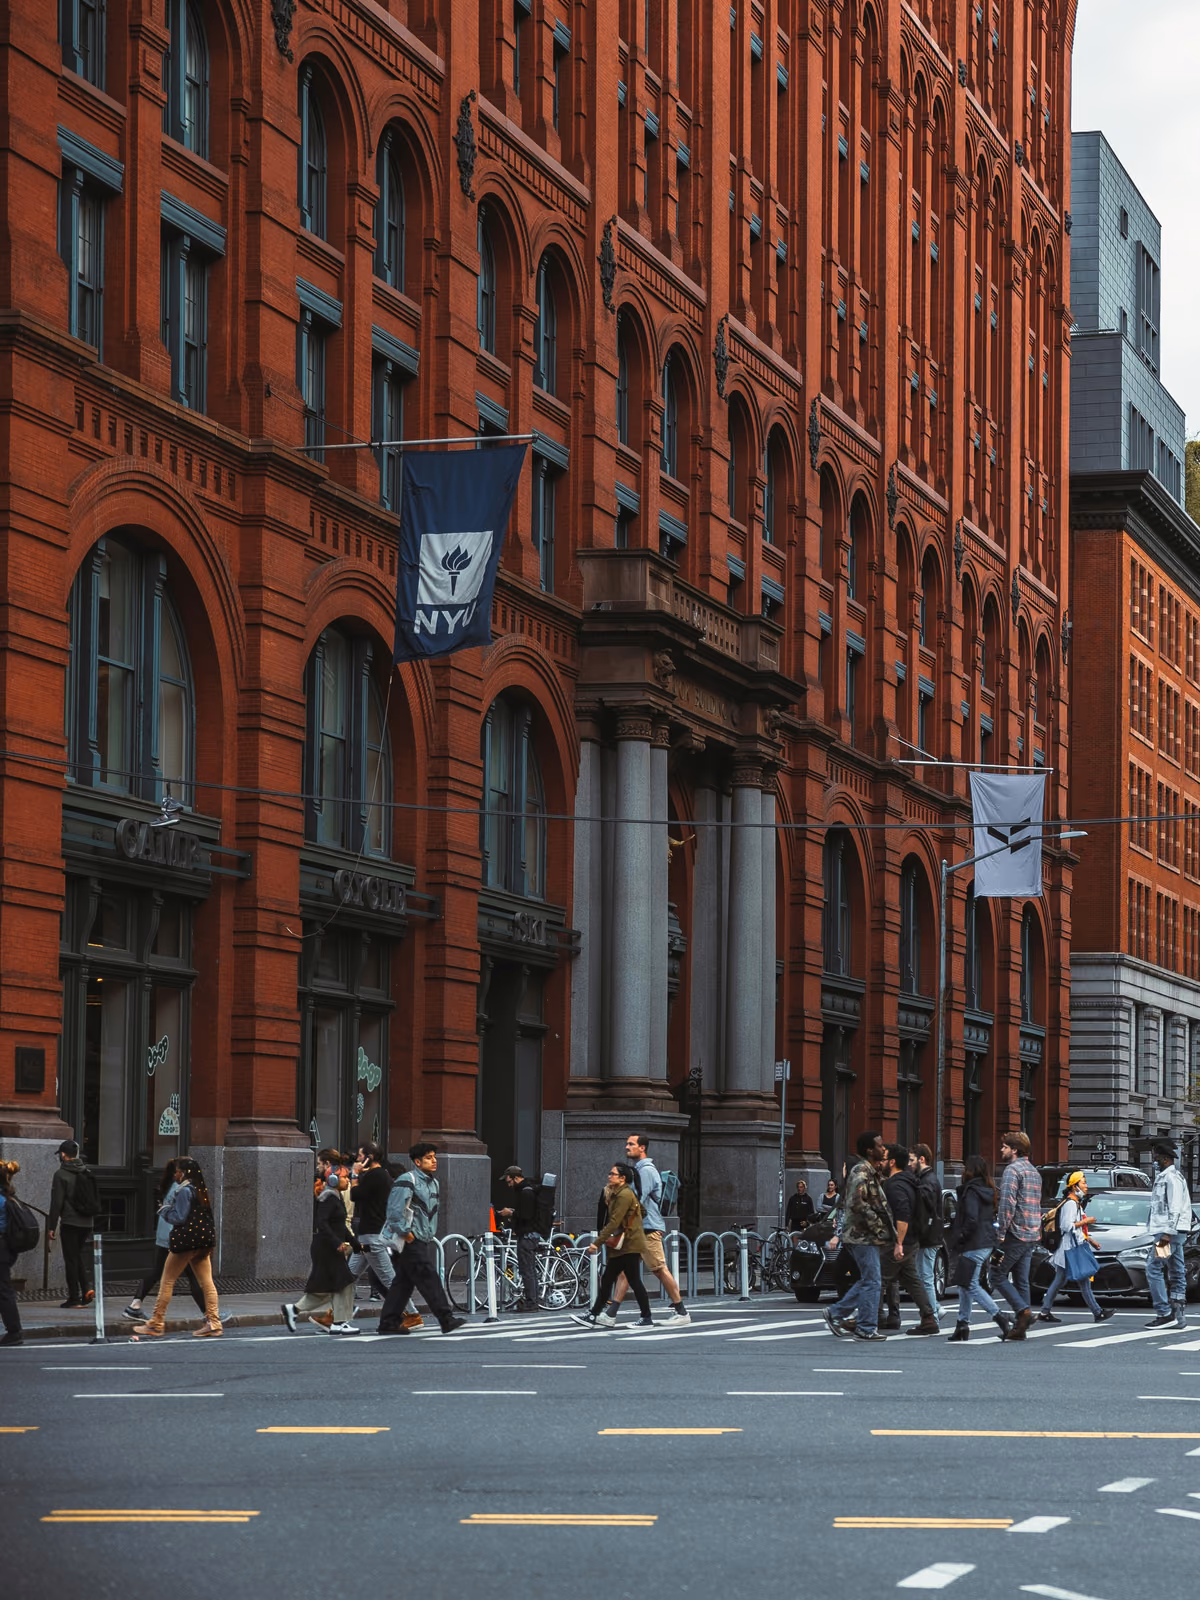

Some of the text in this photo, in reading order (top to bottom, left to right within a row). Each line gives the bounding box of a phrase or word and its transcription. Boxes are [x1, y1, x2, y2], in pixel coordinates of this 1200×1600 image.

[413, 601, 477, 634] NYU
[116, 818, 199, 870] CAMP
[334, 869, 407, 915] CYCLE
[513, 910, 547, 946] SKI
